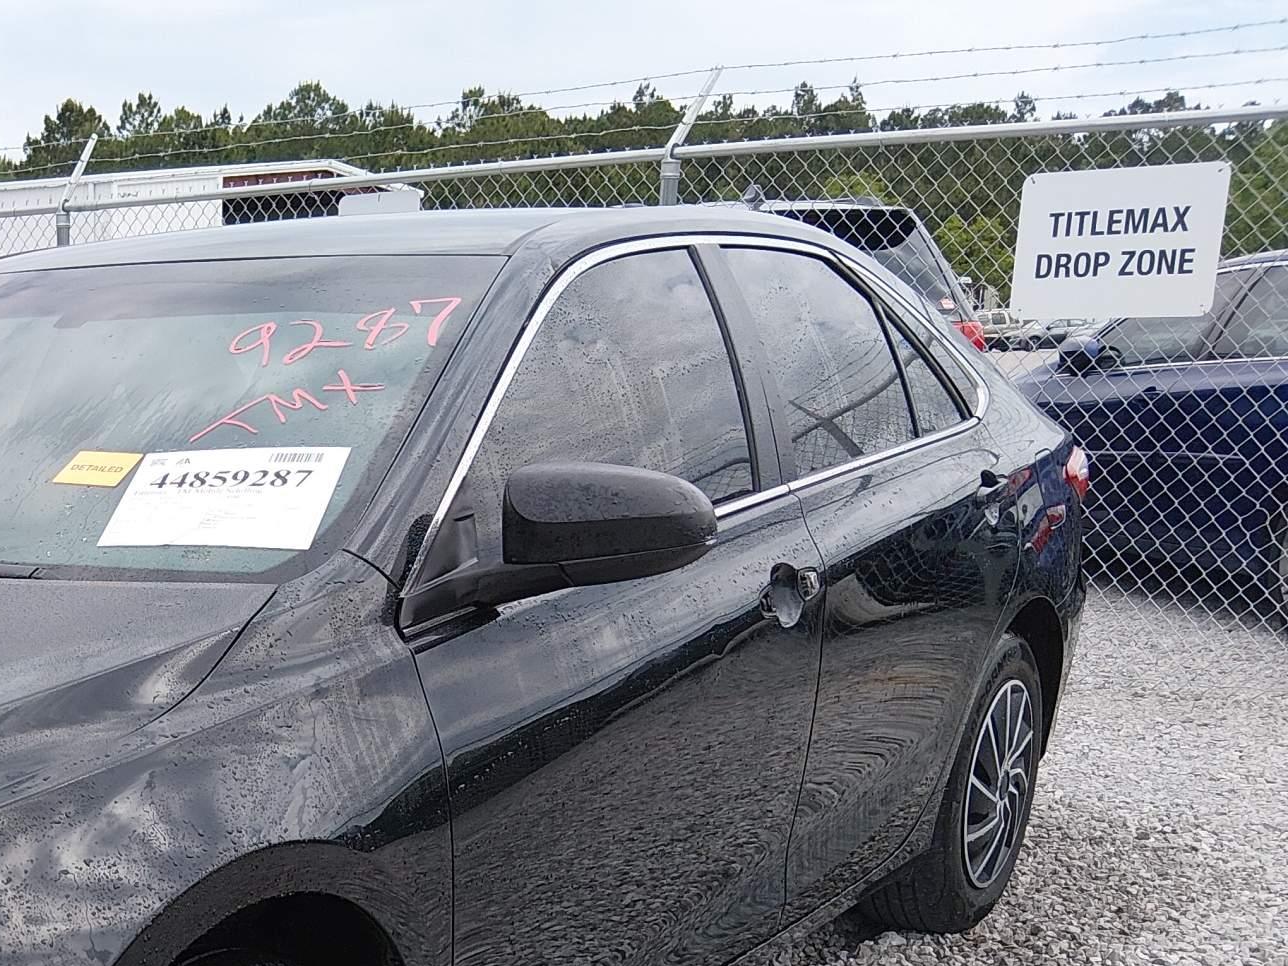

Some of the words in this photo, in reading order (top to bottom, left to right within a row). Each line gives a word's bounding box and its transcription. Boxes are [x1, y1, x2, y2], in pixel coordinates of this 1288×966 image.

[1049, 205, 1192, 237] TITLEMAX
[1034, 251, 1111, 279] DROP
[1117, 248, 1196, 276] ZONE
[228, 297, 462, 367] 9287
[70, 464, 124, 473] DETAILED
[149, 469, 314, 489] 44859287
